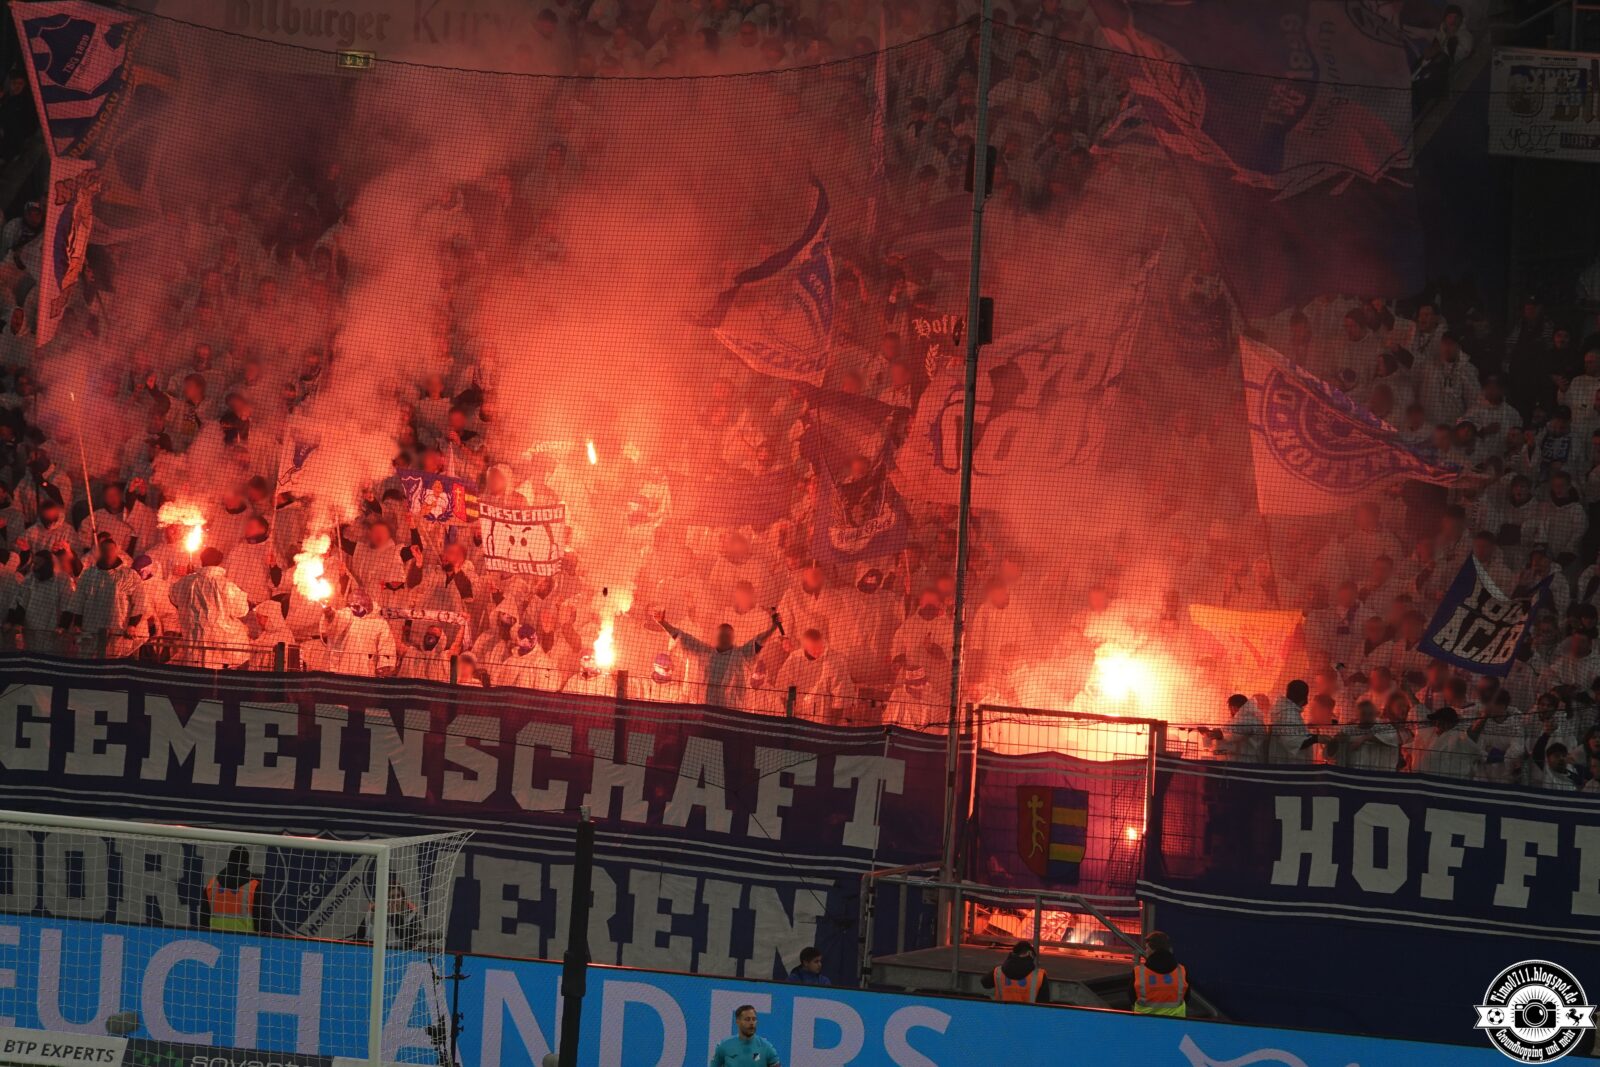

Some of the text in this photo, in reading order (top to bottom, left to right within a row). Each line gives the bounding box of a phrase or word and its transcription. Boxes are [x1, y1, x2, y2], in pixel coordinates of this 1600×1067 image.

[1432, 605, 1526, 665] ACAB
[0, 683, 906, 850] GEMEINSCHAFT
[3, 1039, 115, 1063] BTP EXPERTS
